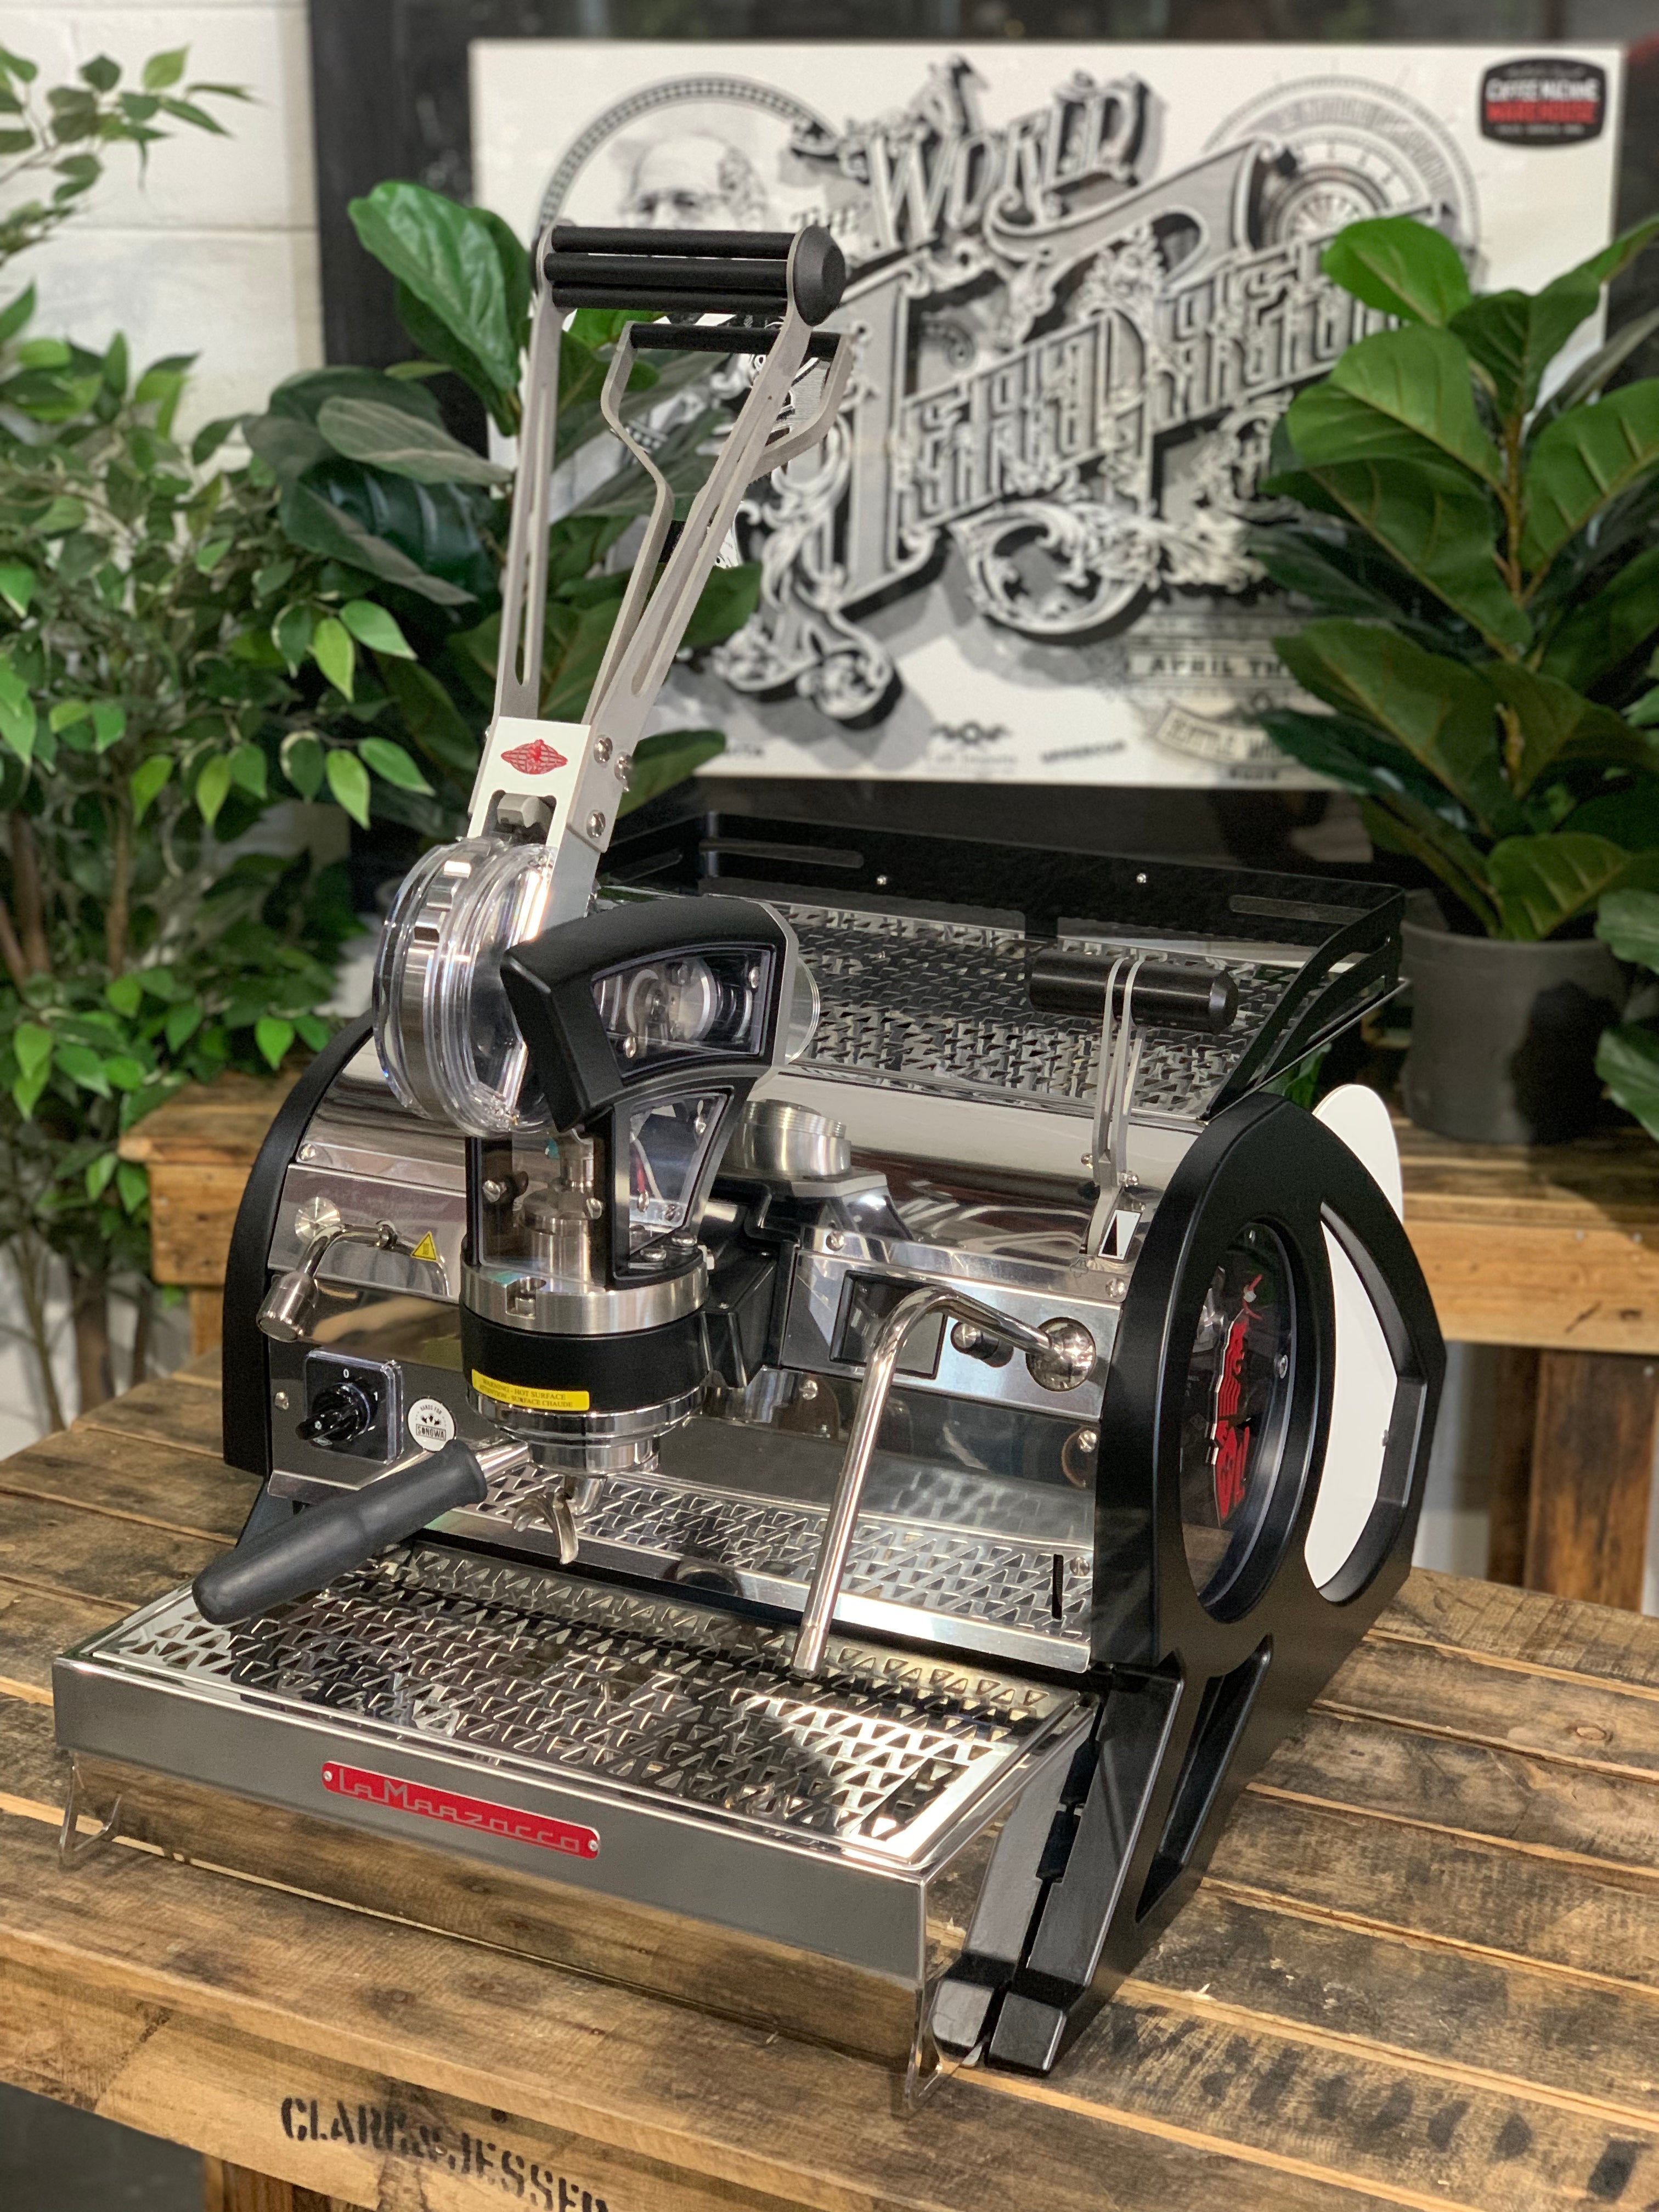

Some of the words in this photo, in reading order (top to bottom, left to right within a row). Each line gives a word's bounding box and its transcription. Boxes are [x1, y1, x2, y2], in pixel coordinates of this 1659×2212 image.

[1150, 656, 1233, 676] APRIL
[343, 1368, 349, 1379] 0
[483, 1379, 510, 1393] WARNING
[479, 1385, 507, 1400] ATTENTION
[511, 1396, 541, 1406] SURFACE
[434, 1406, 442, 1414] FOR
